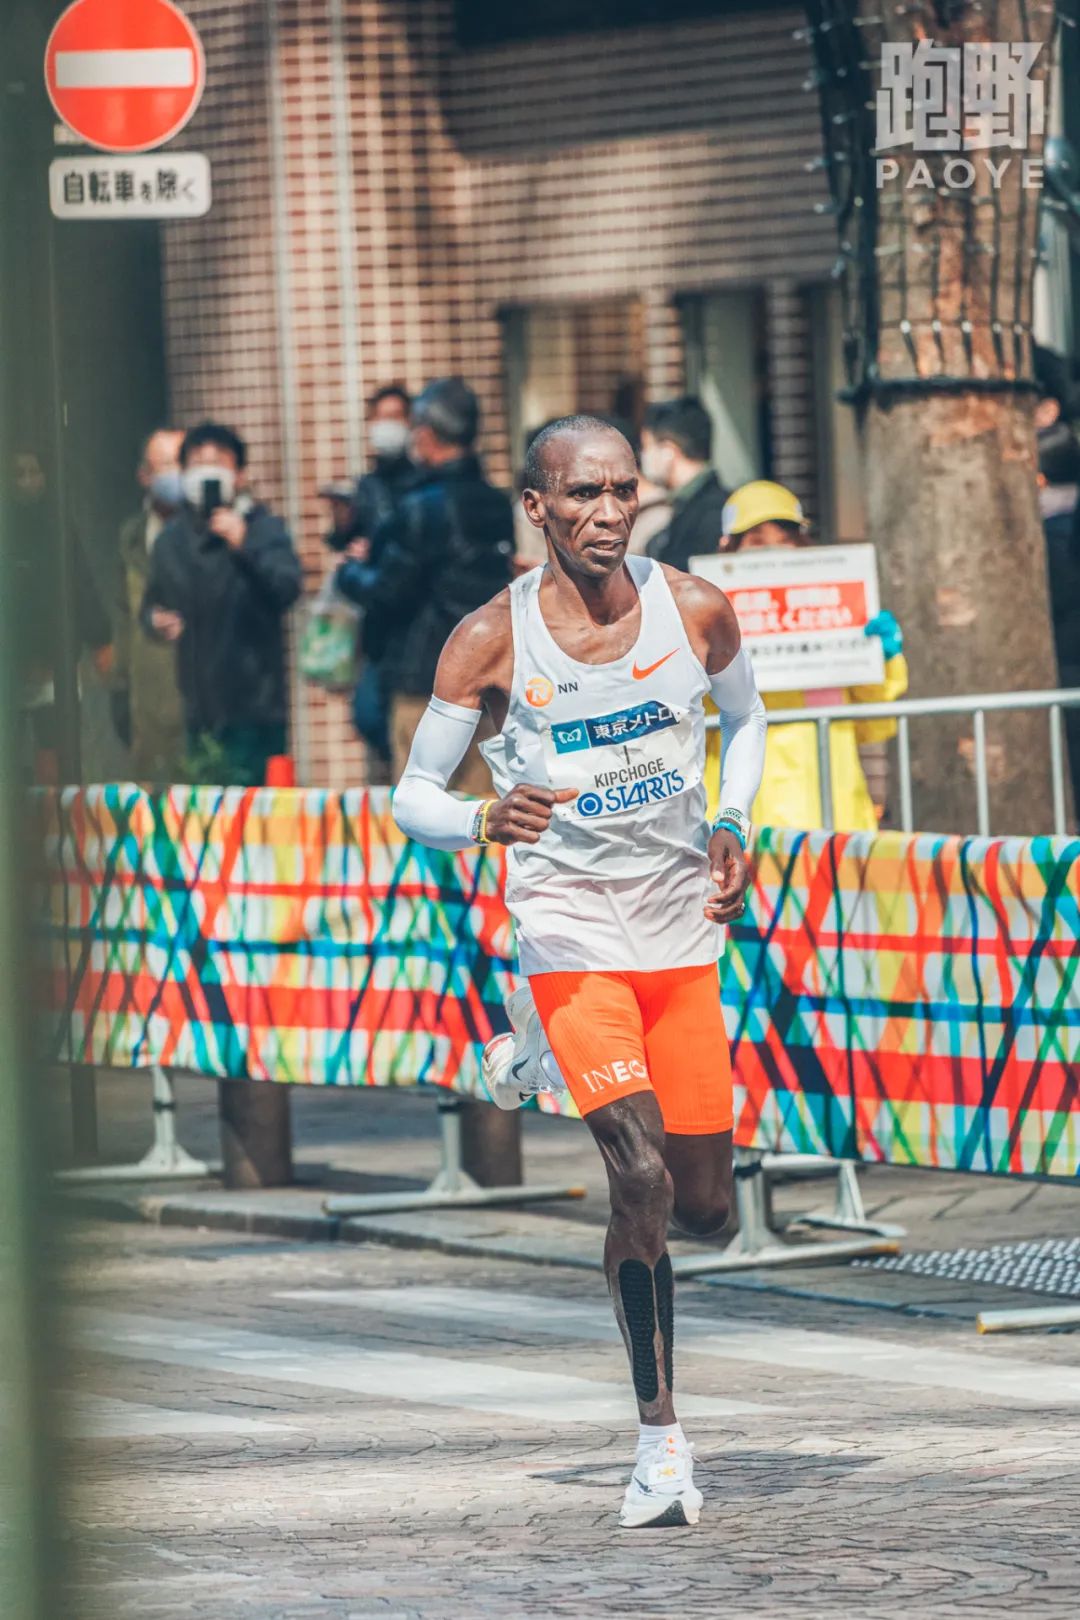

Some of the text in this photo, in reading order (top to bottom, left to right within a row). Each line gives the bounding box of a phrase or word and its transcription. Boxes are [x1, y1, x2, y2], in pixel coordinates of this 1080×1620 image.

[62, 168, 197, 205] 自転車を除く
[557, 681, 579, 695] NN
[593, 706, 673, 739] 東京メトロ
[594, 757, 666, 789] KIPCHOGE
[604, 768, 685, 813] STARTS
[581, 1059, 649, 1094] INEO
